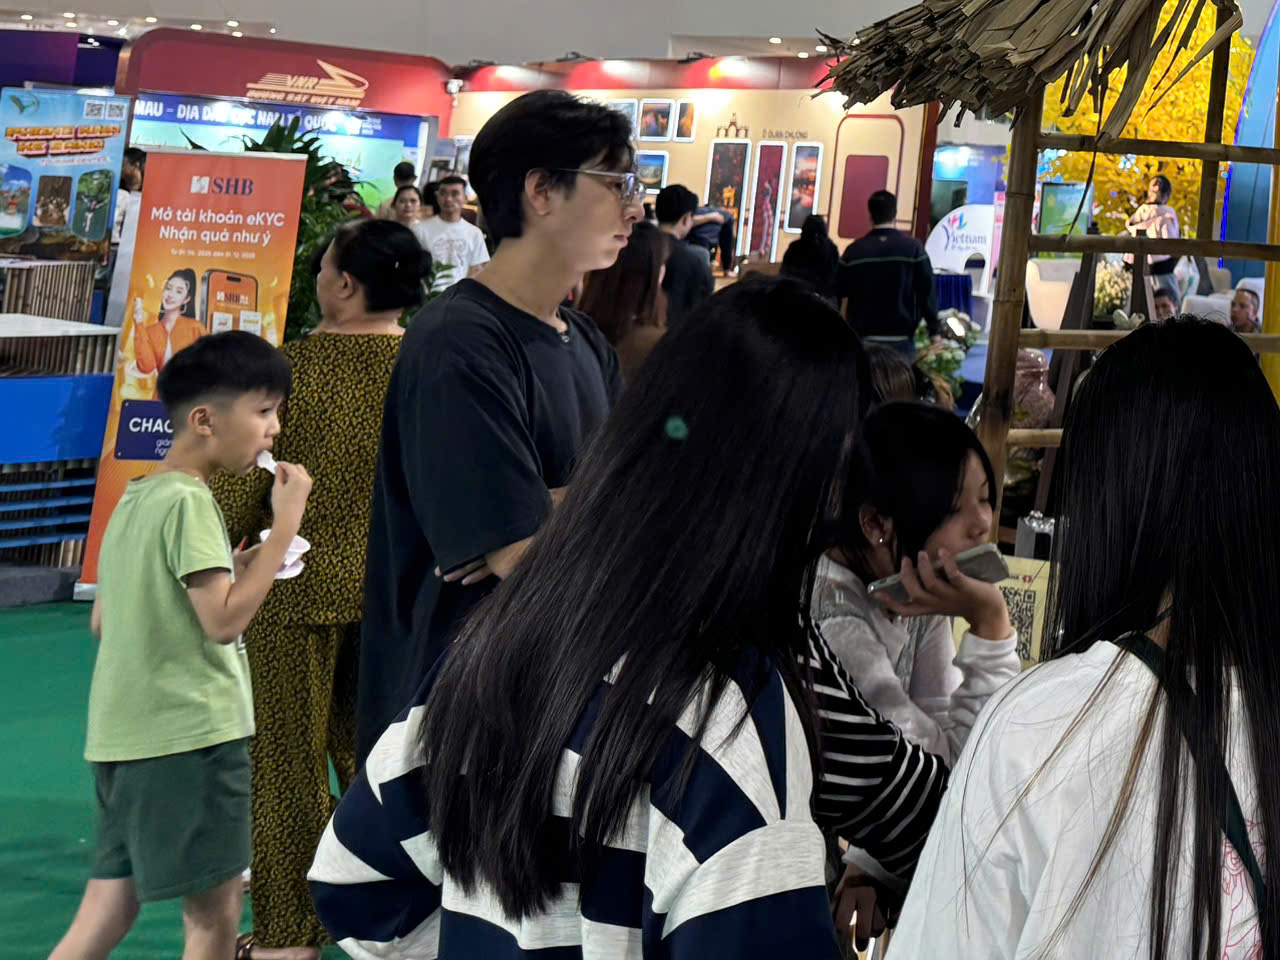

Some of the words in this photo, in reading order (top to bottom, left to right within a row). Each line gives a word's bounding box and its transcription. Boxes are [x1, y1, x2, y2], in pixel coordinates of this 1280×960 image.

[212, 177, 254, 196] SHB
[151, 206, 173, 221] Mở
[176, 208, 195, 222] tài
[199, 208, 243, 224] khoản
[247, 212, 285, 227] eKYC
[160, 225, 197, 243] Nhận
[233, 229, 259, 243] như
[262, 230, 271, 247] ý
